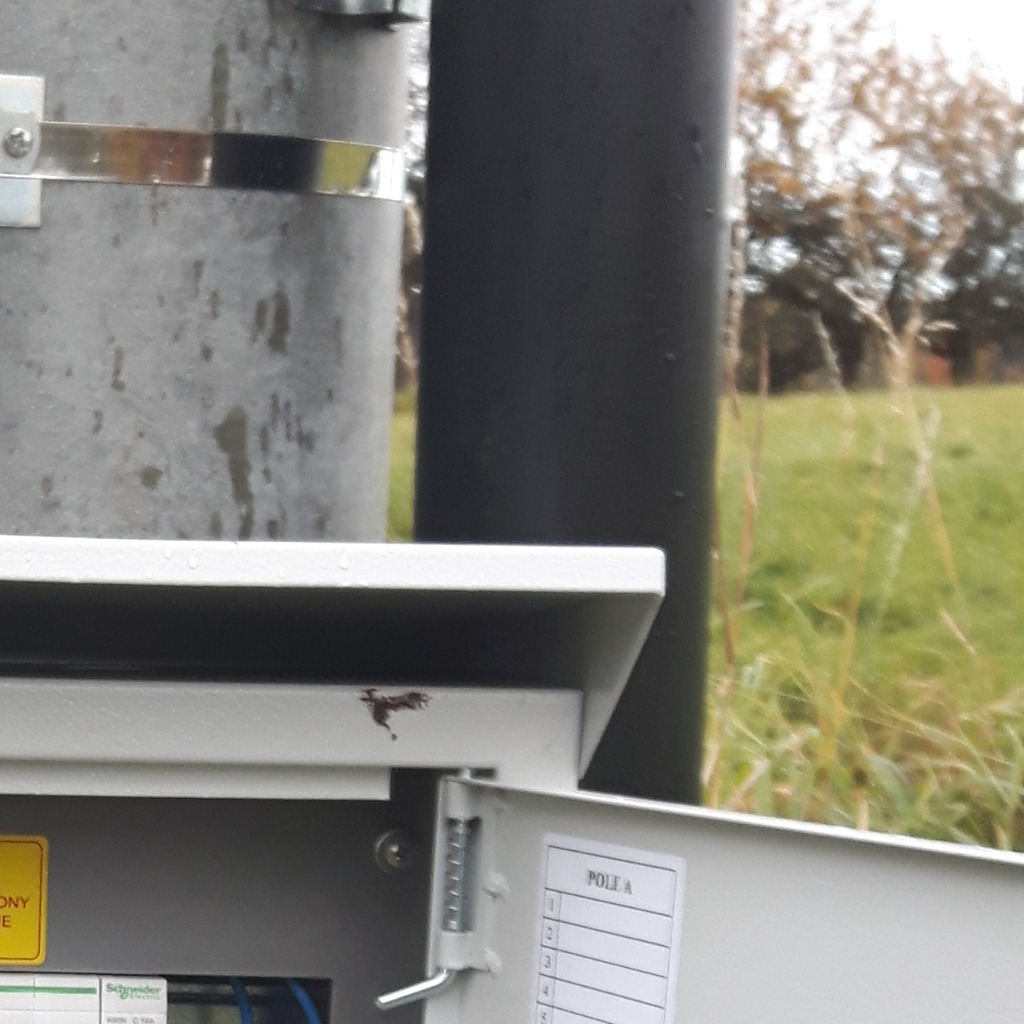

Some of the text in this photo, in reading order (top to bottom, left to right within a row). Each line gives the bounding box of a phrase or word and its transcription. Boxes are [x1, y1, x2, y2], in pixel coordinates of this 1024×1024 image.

[587, 869, 633, 895] POLE A
[543, 955, 552, 969] 3
[106, 982, 162, 1000] Schneider
[132, 1016, 139, 1024] C
